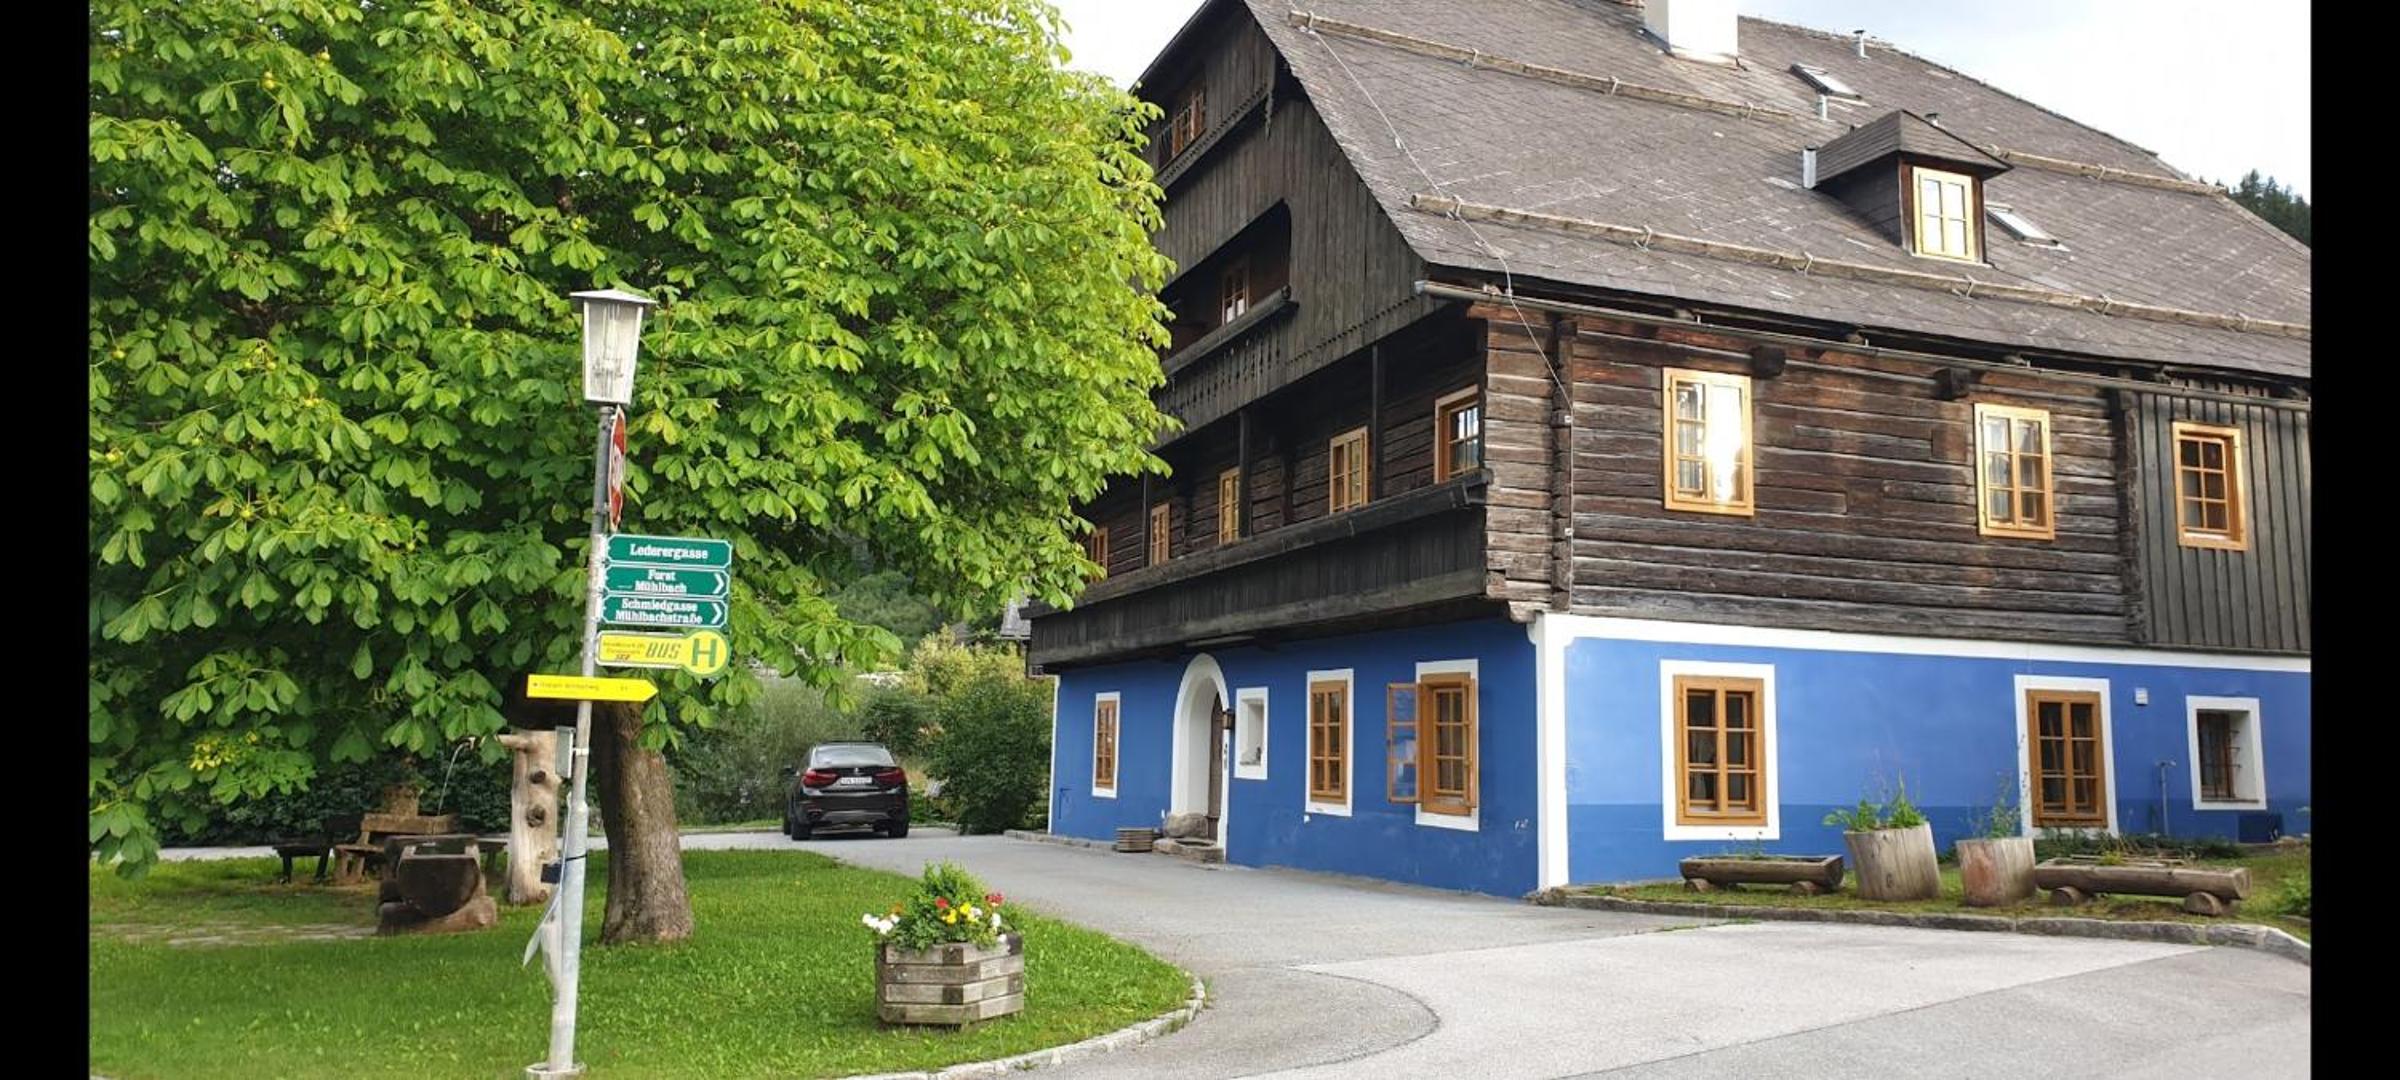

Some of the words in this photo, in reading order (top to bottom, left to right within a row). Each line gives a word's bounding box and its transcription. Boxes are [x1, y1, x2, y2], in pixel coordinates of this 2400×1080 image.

[629, 543, 709, 560] Lederergasse
[635, 581, 688, 594] Mühlbach
[621, 598, 698, 613] Schmiedgasse
[615, 610, 703, 625] Mühlbachstraße
[645, 642, 681, 659] BUS
[692, 638, 717, 668] H
